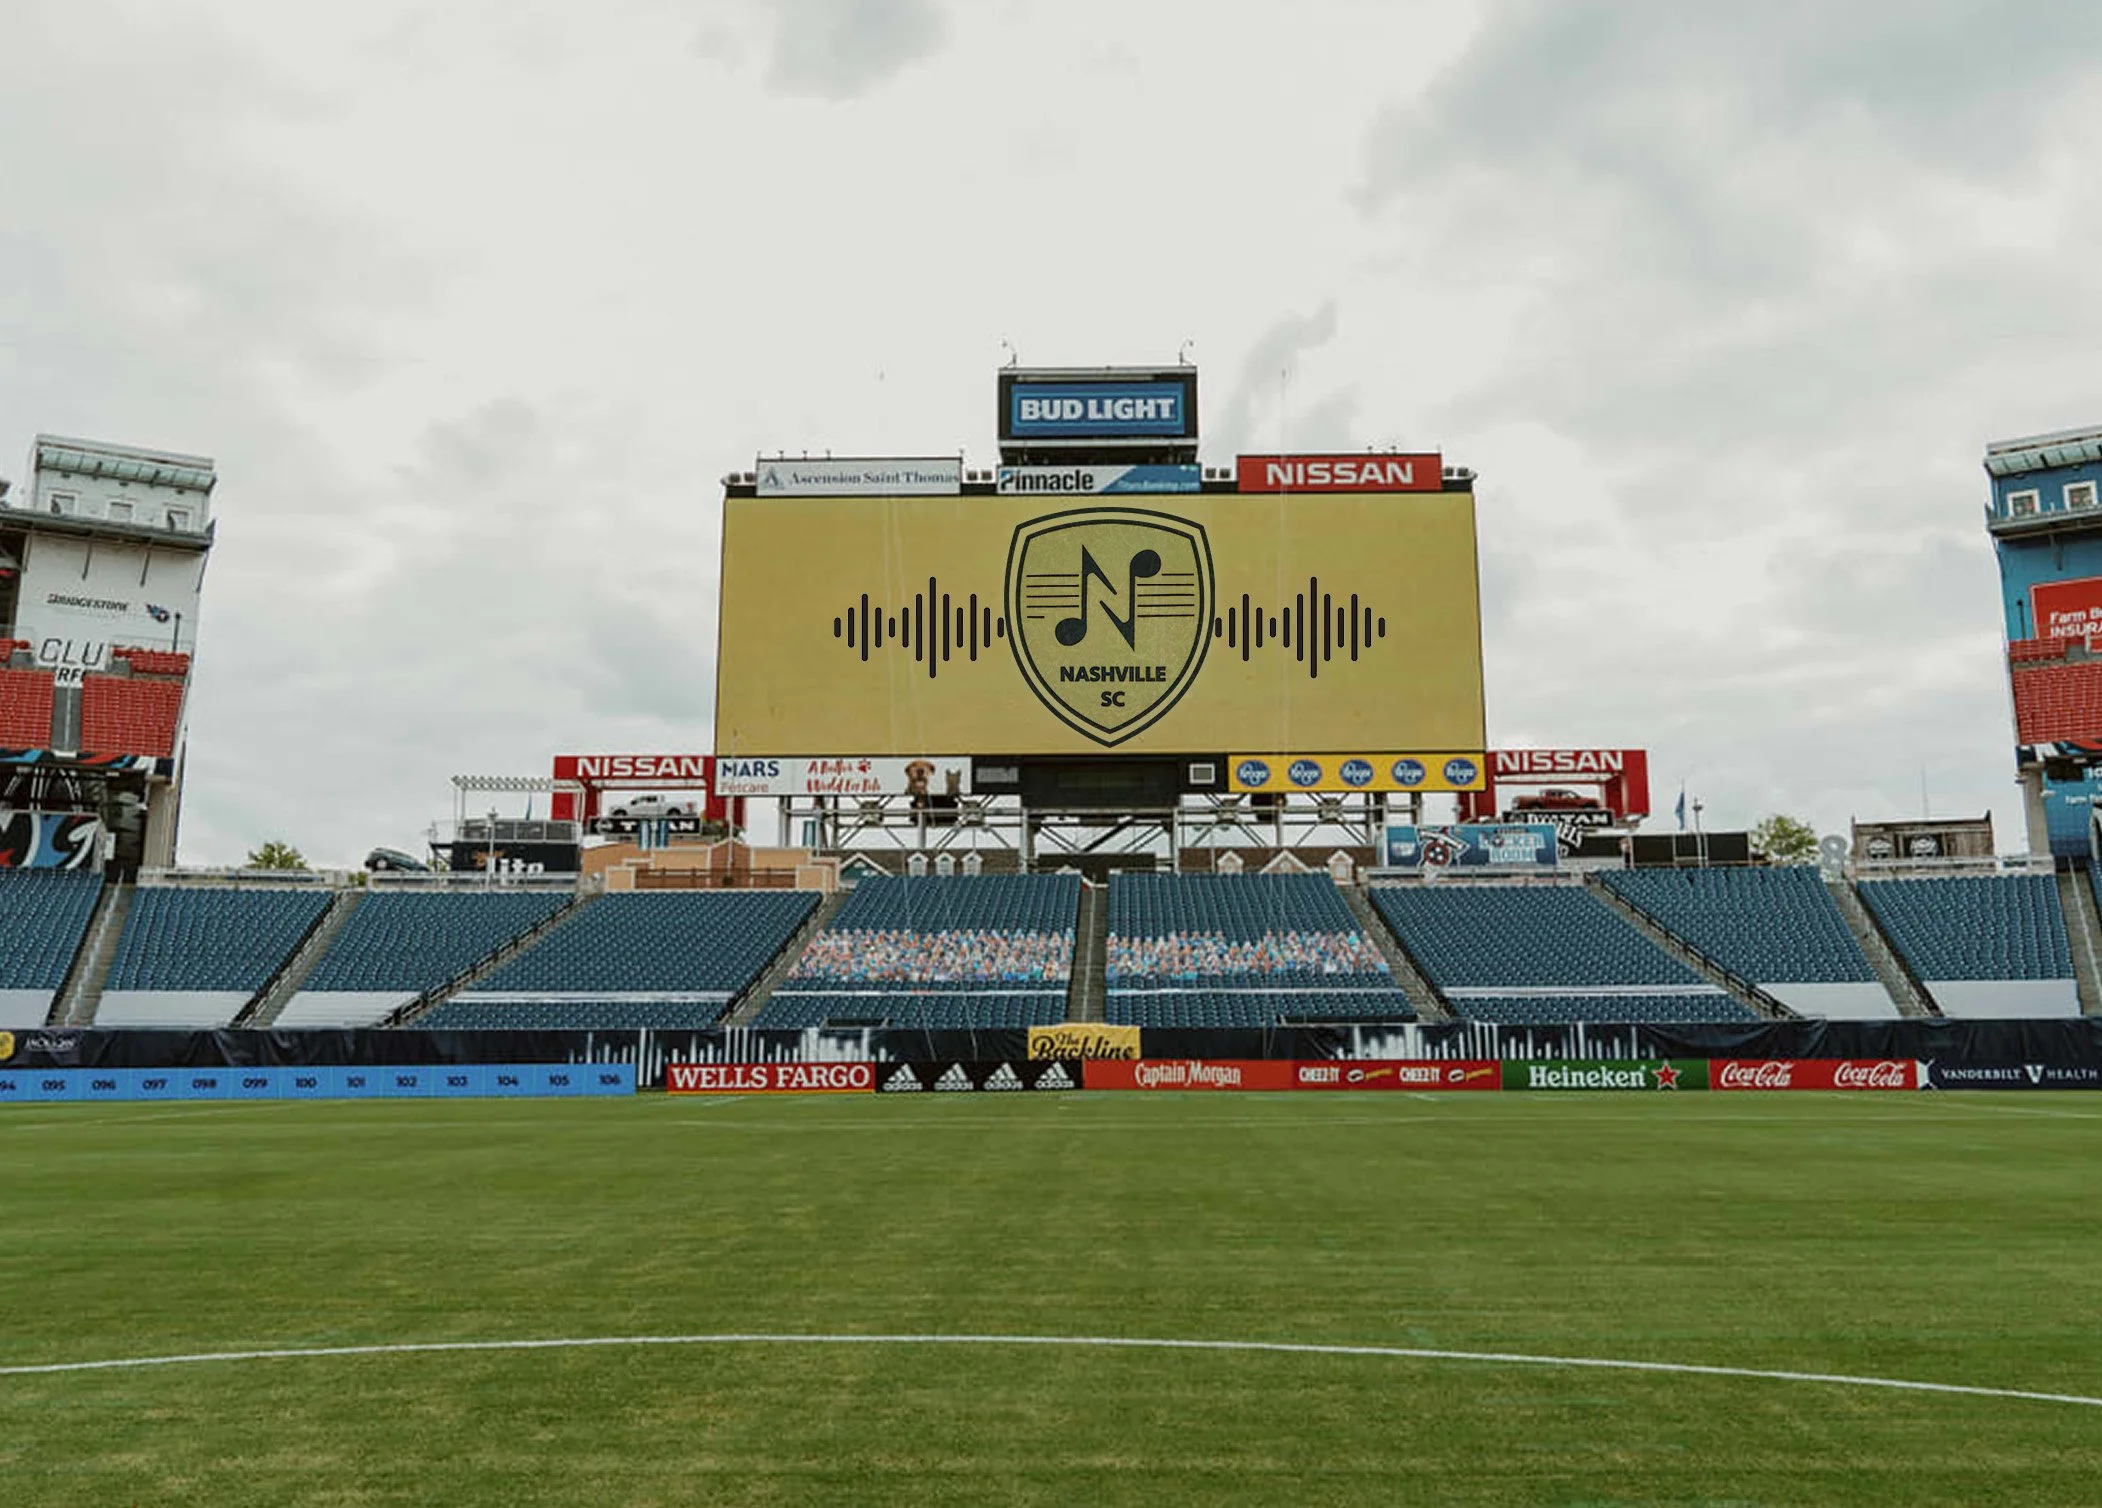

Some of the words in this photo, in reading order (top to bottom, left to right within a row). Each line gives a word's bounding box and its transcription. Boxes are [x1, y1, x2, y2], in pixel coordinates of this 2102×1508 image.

[1021, 398, 1083, 420] BUD
[1088, 398, 1174, 420] LIGHT
[791, 472, 860, 485] Ascension
[863, 471, 900, 484] Saint
[903, 471, 959, 483] Thomas
[1000, 469, 1094, 491] Pinnacle
[1266, 462, 1413, 485] NISSAN
[2050, 610, 2086, 625] Farm
[1060, 666, 1166, 682] NASHVILLE
[1100, 691, 1125, 707] SC
[577, 758, 703, 776] NISSAN
[722, 761, 779, 777] MARS
[1496, 751, 1623, 771] NISSAN
[720, 781, 769, 793] Petcare
[1056, 1031, 1080, 1045] The
[1032, 1035, 1133, 1060] Backline
[672, 1066, 768, 1089] WELLS
[776, 1065, 870, 1087] FARGO
[1135, 1060, 1185, 1087] Captain
[1184, 1060, 1242, 1087] Morgan
[1529, 1064, 1646, 1087] Heineken
[1941, 1068, 2021, 1080] VANDERBILT
[2047, 1068, 2098, 1079] HEALTH
[42, 1079, 66, 1091] 095
[92, 1079, 116, 1091] 096
[142, 1078, 166, 1090] 097
[192, 1078, 217, 1089] 098
[243, 1077, 267, 1089] 099
[296, 1078, 317, 1089] 100
[346, 1076, 366, 1088] 101
[396, 1076, 417, 1087] 102
[447, 1075, 468, 1087] 103
[497, 1075, 518, 1087] 104
[550, 1075, 570, 1086] 105
[600, 1074, 621, 1085] 106
[883, 1080, 923, 1091] adidas
[934, 1080, 974, 1091] adidas
[983, 1080, 1024, 1090] adidas
[1034, 1079, 1075, 1089] adidas
